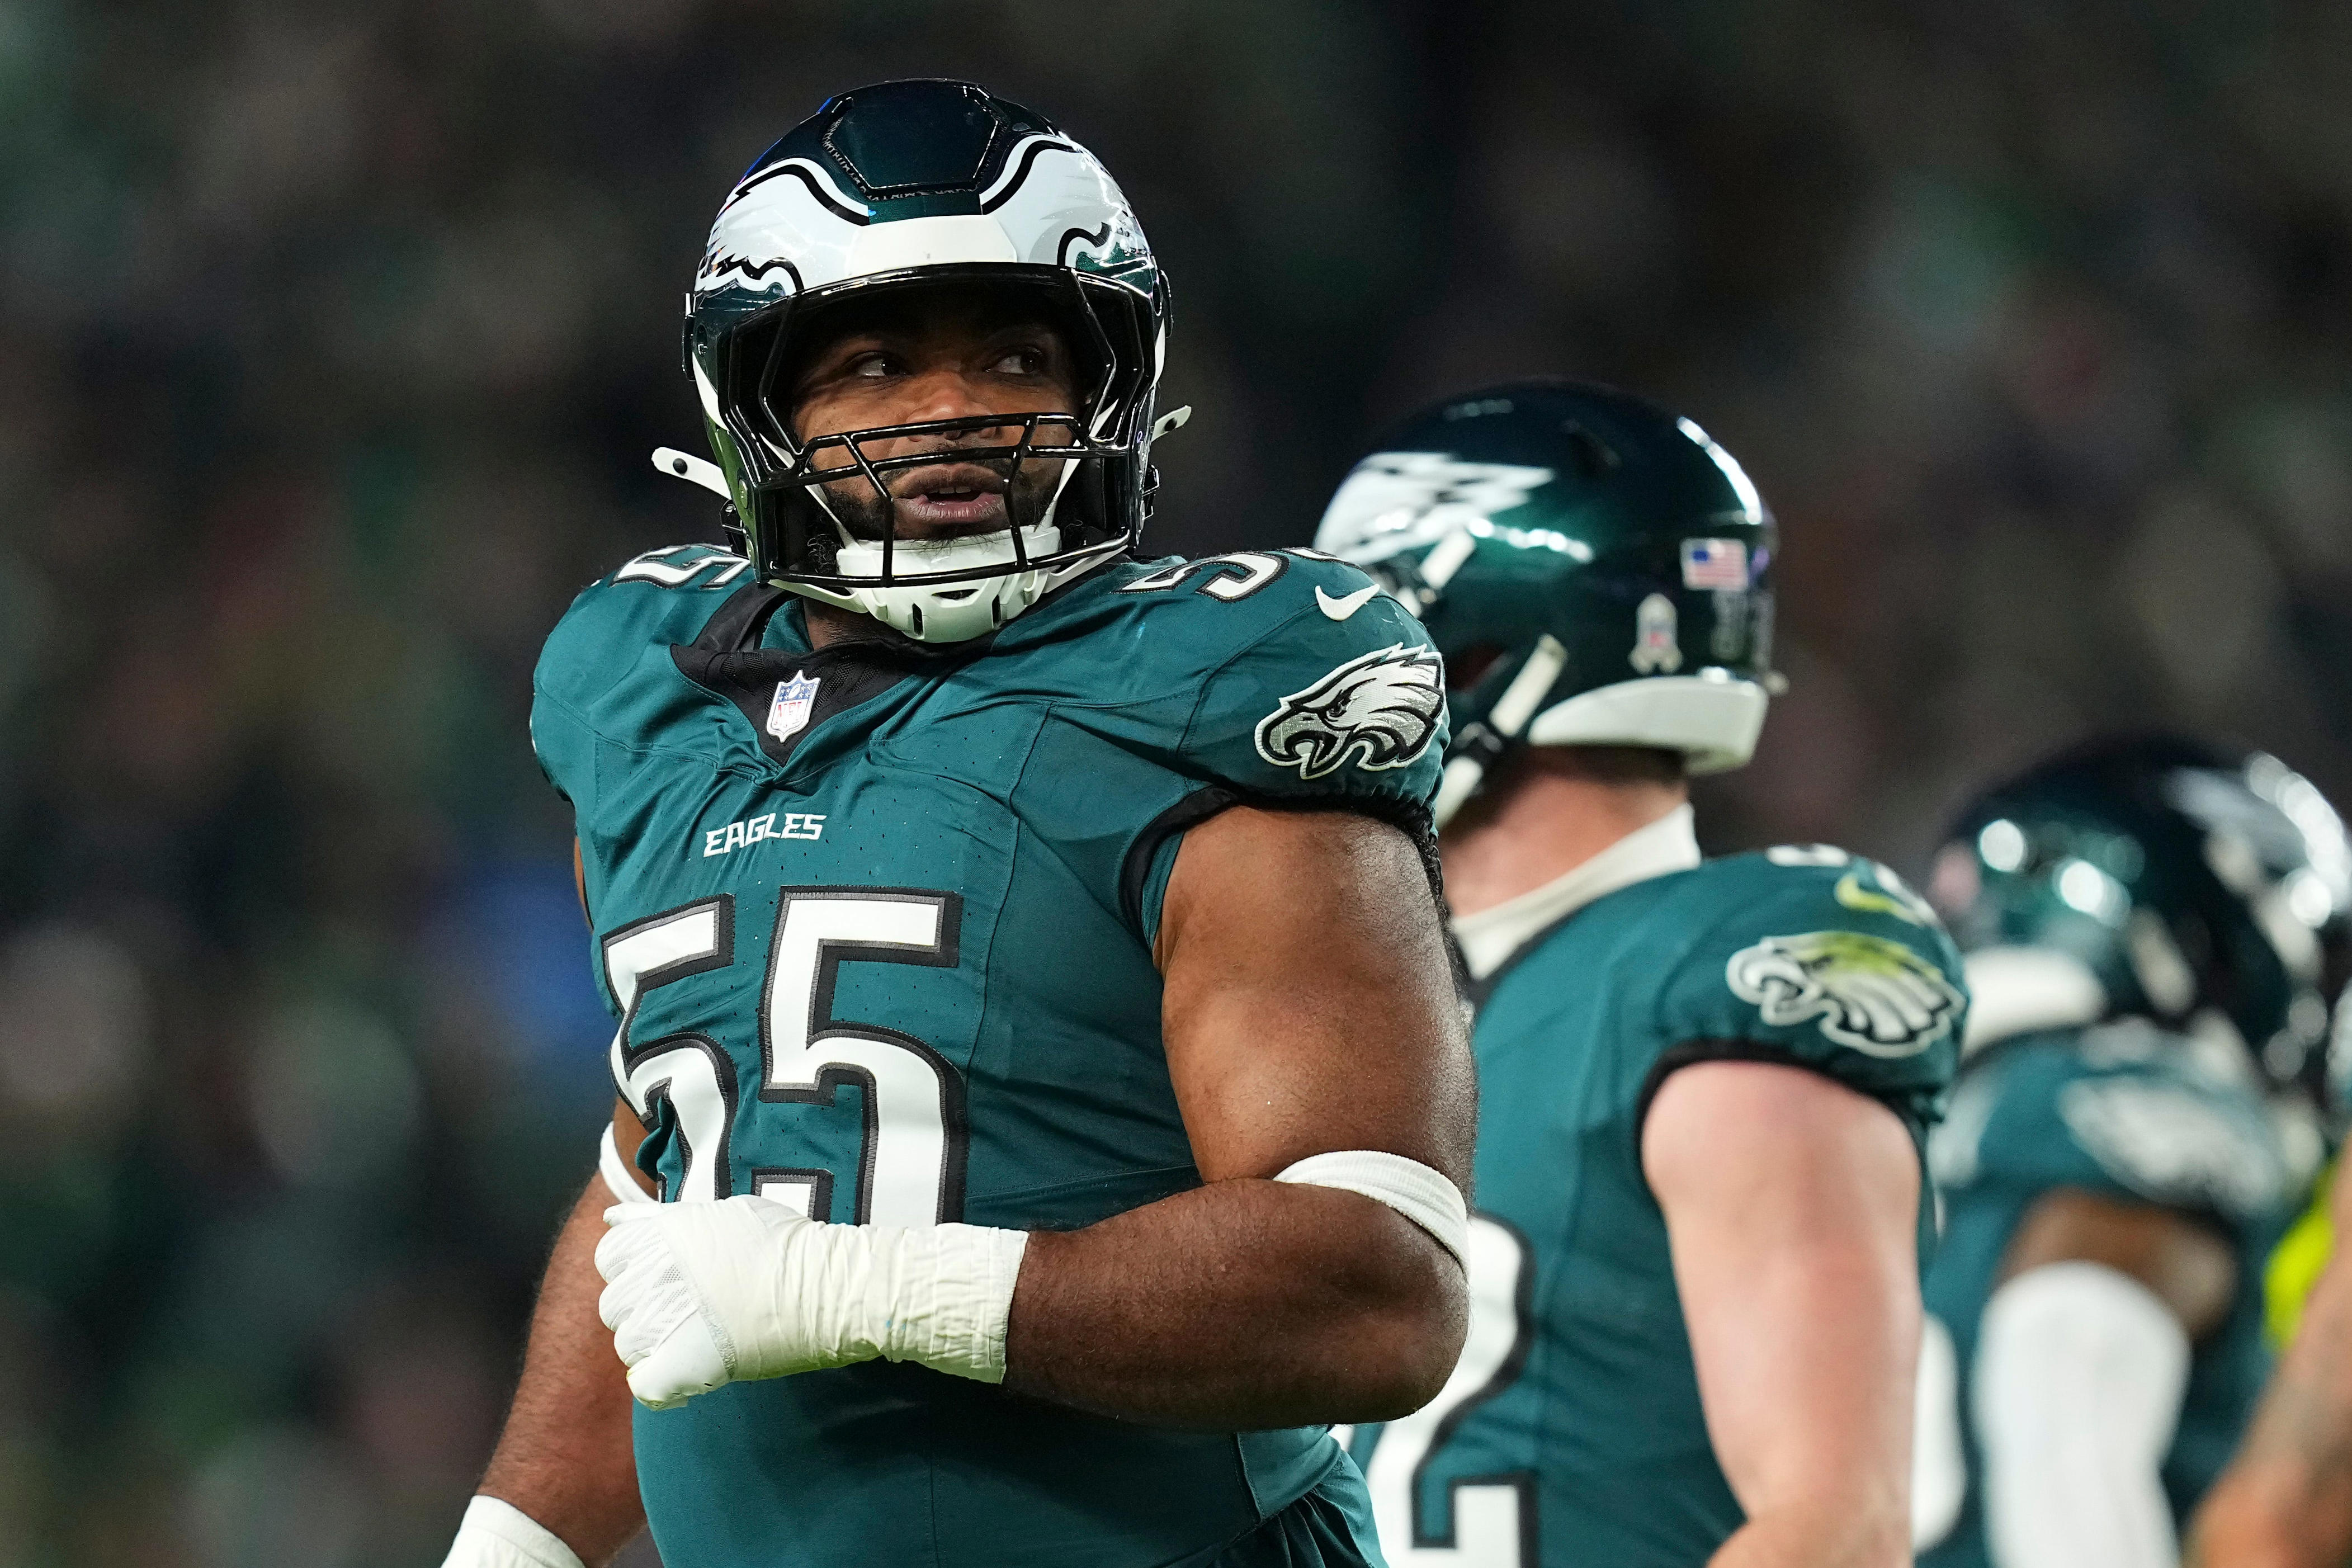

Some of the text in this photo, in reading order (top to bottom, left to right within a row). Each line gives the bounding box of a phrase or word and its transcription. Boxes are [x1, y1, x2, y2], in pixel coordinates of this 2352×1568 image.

[703, 813, 828, 858] EAGLES
[600, 885, 971, 1226] 55
[1326, 1211, 1541, 1568] 2
